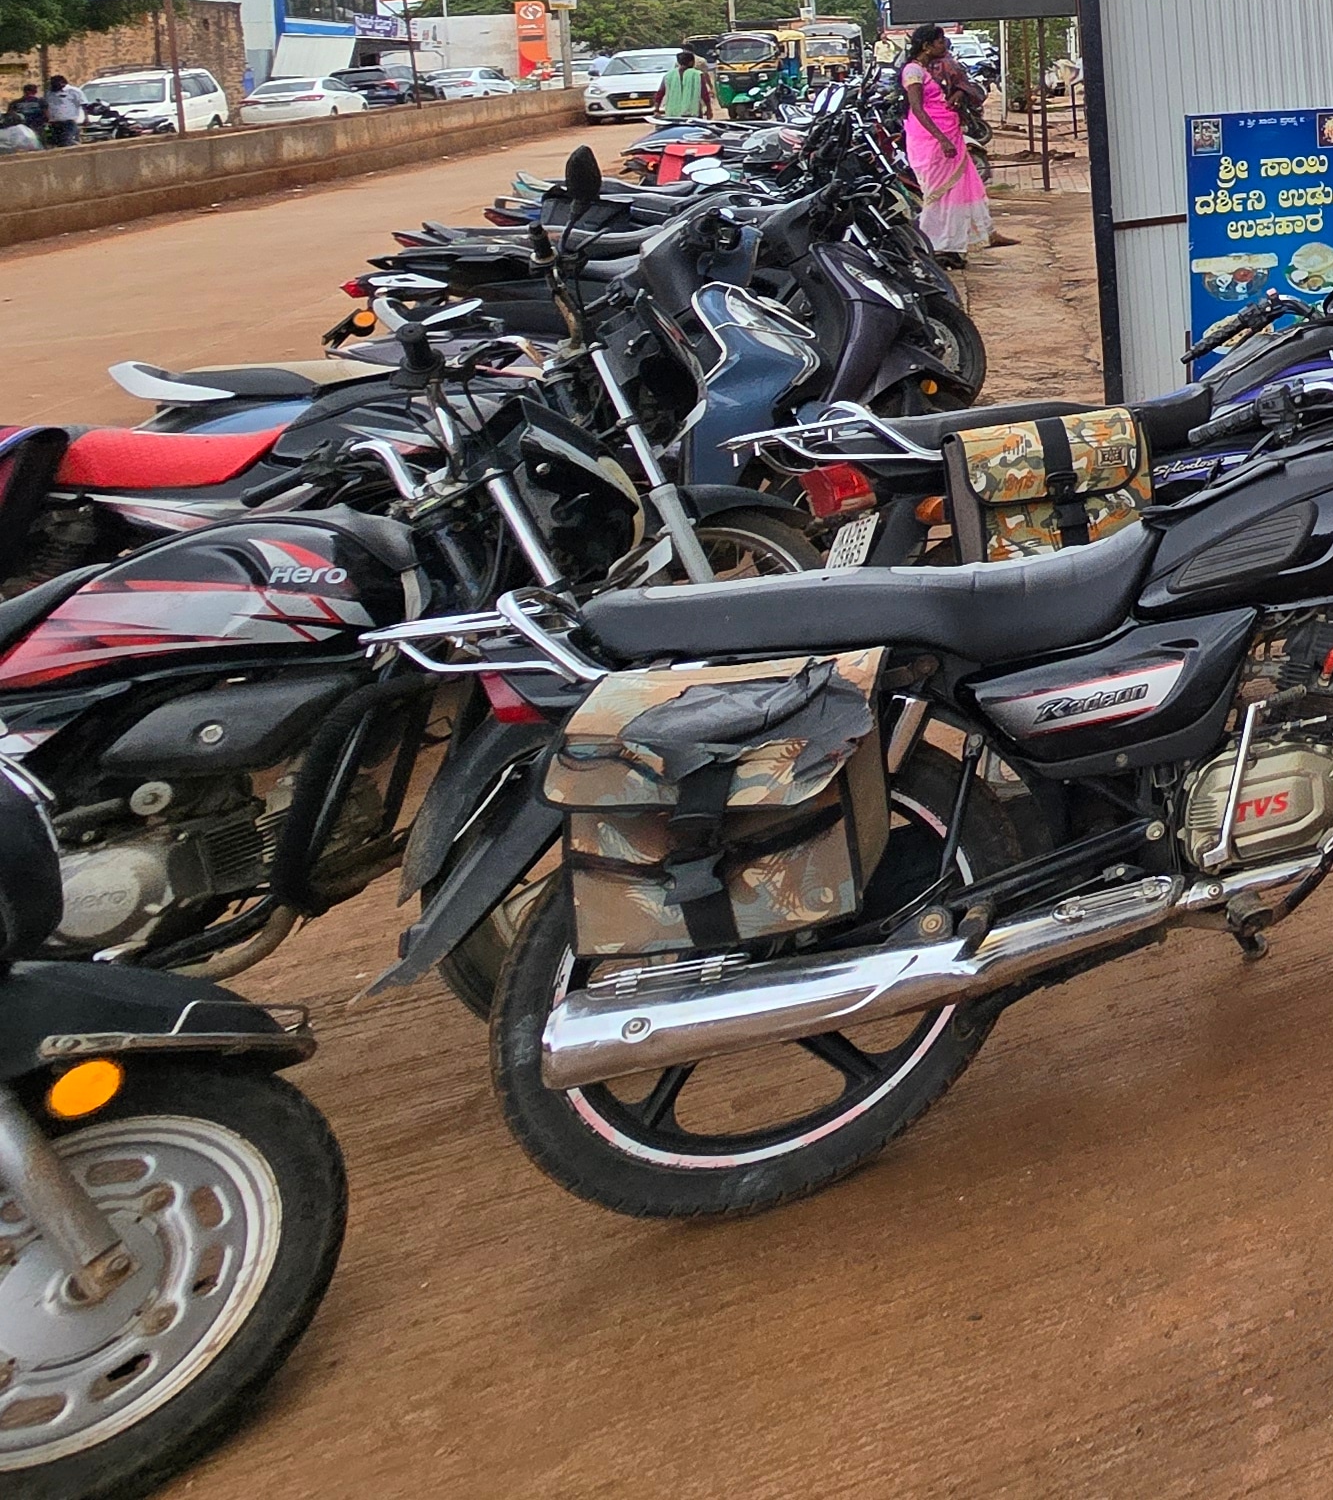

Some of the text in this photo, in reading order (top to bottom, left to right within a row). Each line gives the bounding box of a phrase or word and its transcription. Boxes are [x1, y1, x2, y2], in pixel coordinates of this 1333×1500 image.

[1216, 154, 1328, 188] ಶ್ರೀ ಸಾಯಿ
[1194, 189, 1266, 215] ದರ್ಶಿನಿ
[1227, 208, 1323, 240] ಉಪಹಾರ
[269, 566, 347, 584] Hero
[1033, 683, 1149, 724] Radeon
[1236, 791, 1289, 823] TVS
